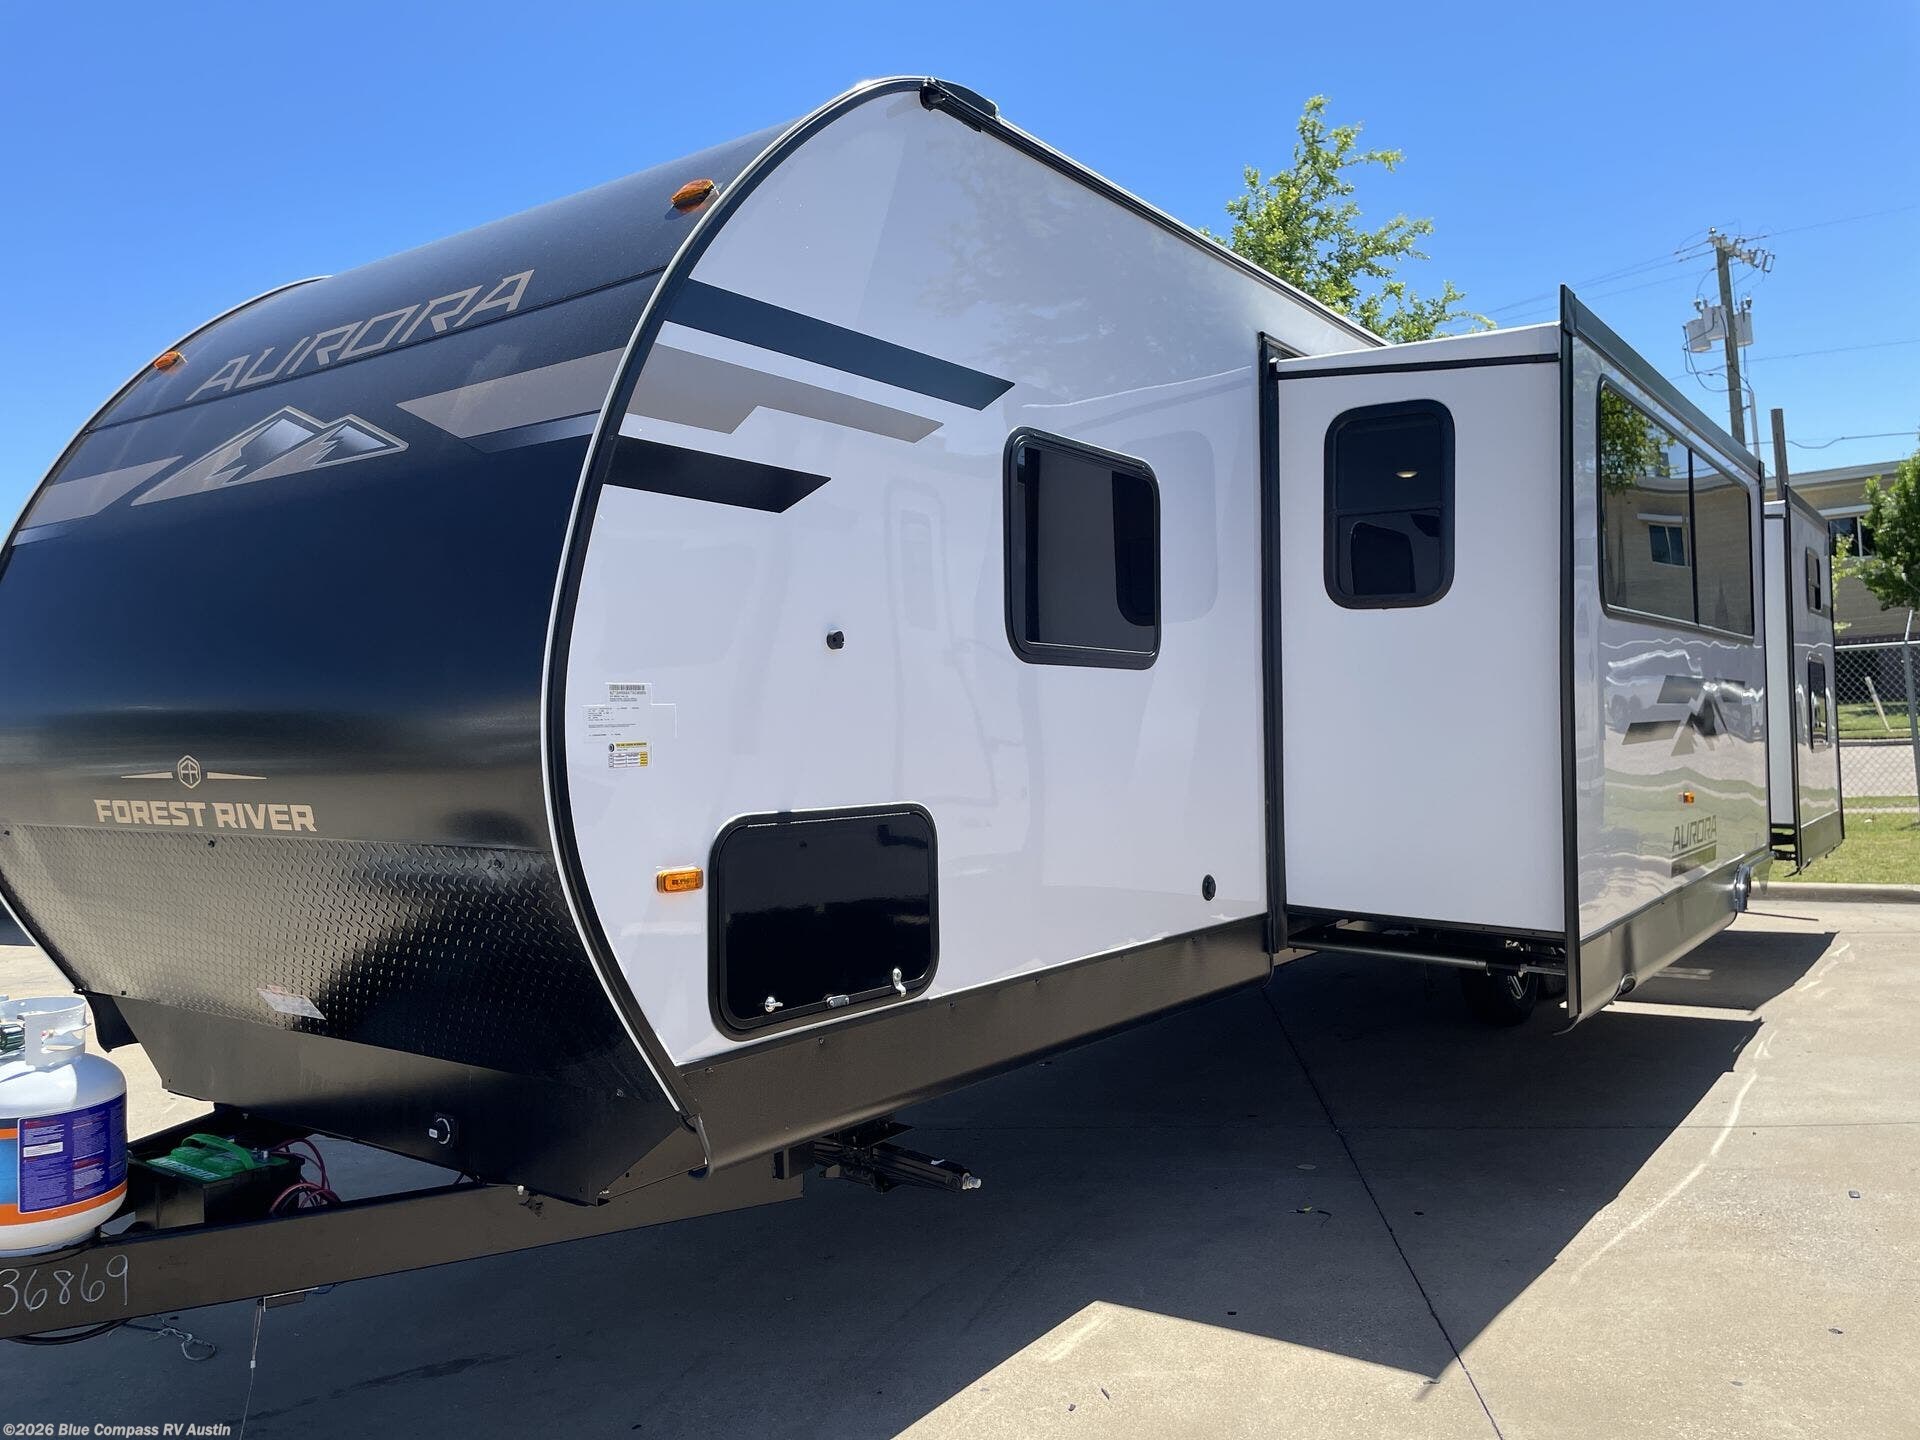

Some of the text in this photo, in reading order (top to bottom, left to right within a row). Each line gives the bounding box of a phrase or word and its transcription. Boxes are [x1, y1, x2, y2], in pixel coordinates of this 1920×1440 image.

[187, 269, 534, 401] AURORA
[94, 799, 317, 831] FOREST RIVER
[1674, 815, 1716, 850] AURORA
